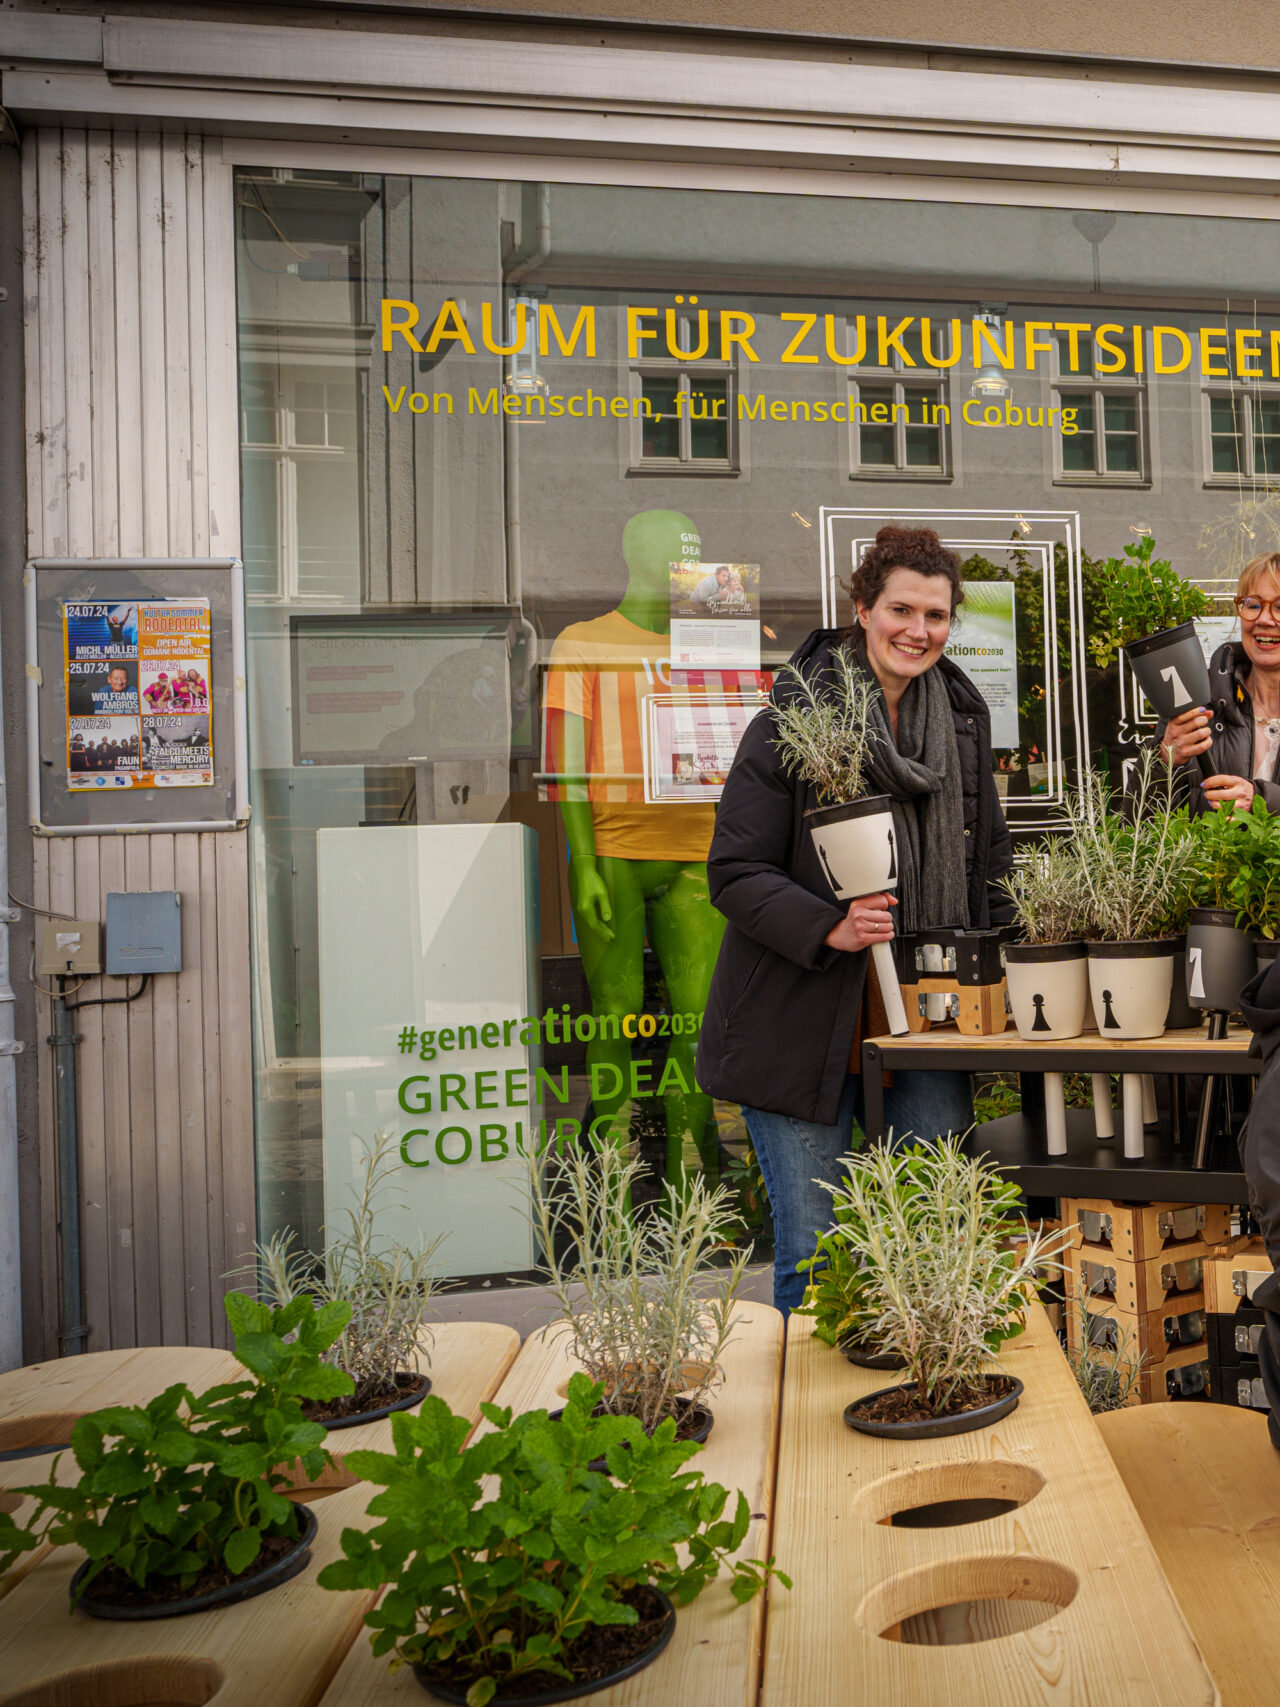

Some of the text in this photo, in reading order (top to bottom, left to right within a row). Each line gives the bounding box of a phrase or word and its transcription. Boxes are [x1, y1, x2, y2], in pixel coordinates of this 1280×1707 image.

[380, 298, 597, 359] RAUM
[627, 294, 762, 363] FÜR
[382, 385, 1080, 435] Von Menschen, für Menschen in Coburg
[69, 605, 109, 617] 24.07.24
[76, 643, 138, 655] MICHL MÜLLER
[157, 639, 192, 647] OPEN AIR
[70, 662, 110, 674] 25.07.24
[141, 660, 181, 672] 26.07.24
[91, 691, 138, 702] WOLFGANG
[102, 701, 138, 710] AMBROS
[70, 717, 112, 730] 27.07.24
[143, 716, 182, 728] 28.07.24
[155, 746, 209, 756] FALCO MEETS
[117, 756, 140, 766] FAUN
[170, 755, 209, 764] MERCURY
[398, 1065, 570, 1115] GREEN
